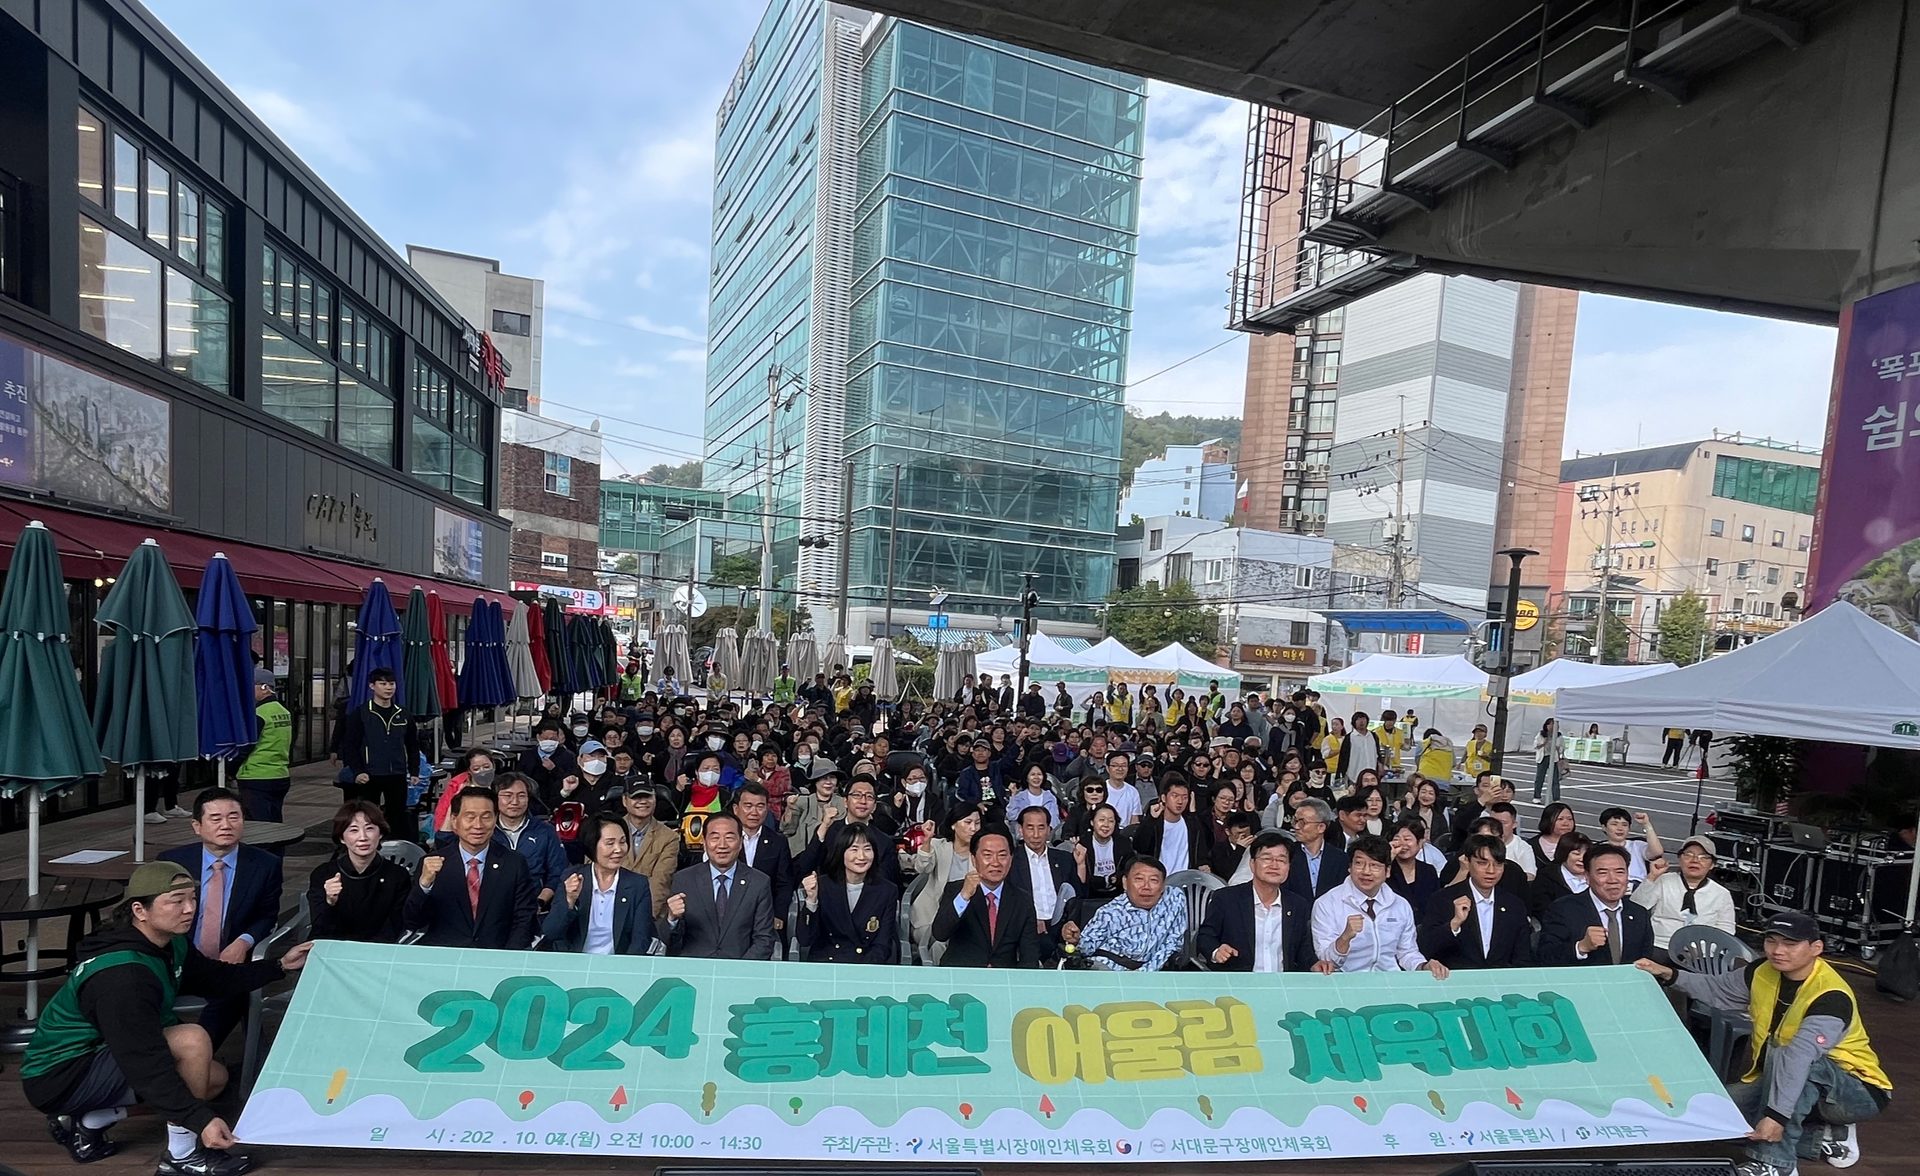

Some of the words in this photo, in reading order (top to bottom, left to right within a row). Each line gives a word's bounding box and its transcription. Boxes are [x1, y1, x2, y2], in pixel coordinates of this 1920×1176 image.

[3, 379, 28, 404] 추진
[403, 975, 699, 1073] 2024
[723, 993, 992, 1084] 홍제천
[1011, 996, 1264, 1084] 어울림
[1277, 991, 1597, 1084] 체육대회
[369, 1127, 389, 1142] 일
[426, 1128, 446, 1144] 시
[606, 1131, 643, 1149] 오전
[650, 1134, 695, 1149] 10:00
[719, 1136, 763, 1150] 14:30
[821, 1136, 892, 1154] 주최/주관
[927, 1137, 1113, 1156] 서울특별시장애인체육회
[1171, 1135, 1333, 1155] 서대문구장애인체육회
[1383, 1133, 1400, 1150] 후
[1428, 1131, 1445, 1148] 원
[1479, 1127, 1556, 1146] 서울특별시
[1594, 1125, 1649, 1139] 서대문구
